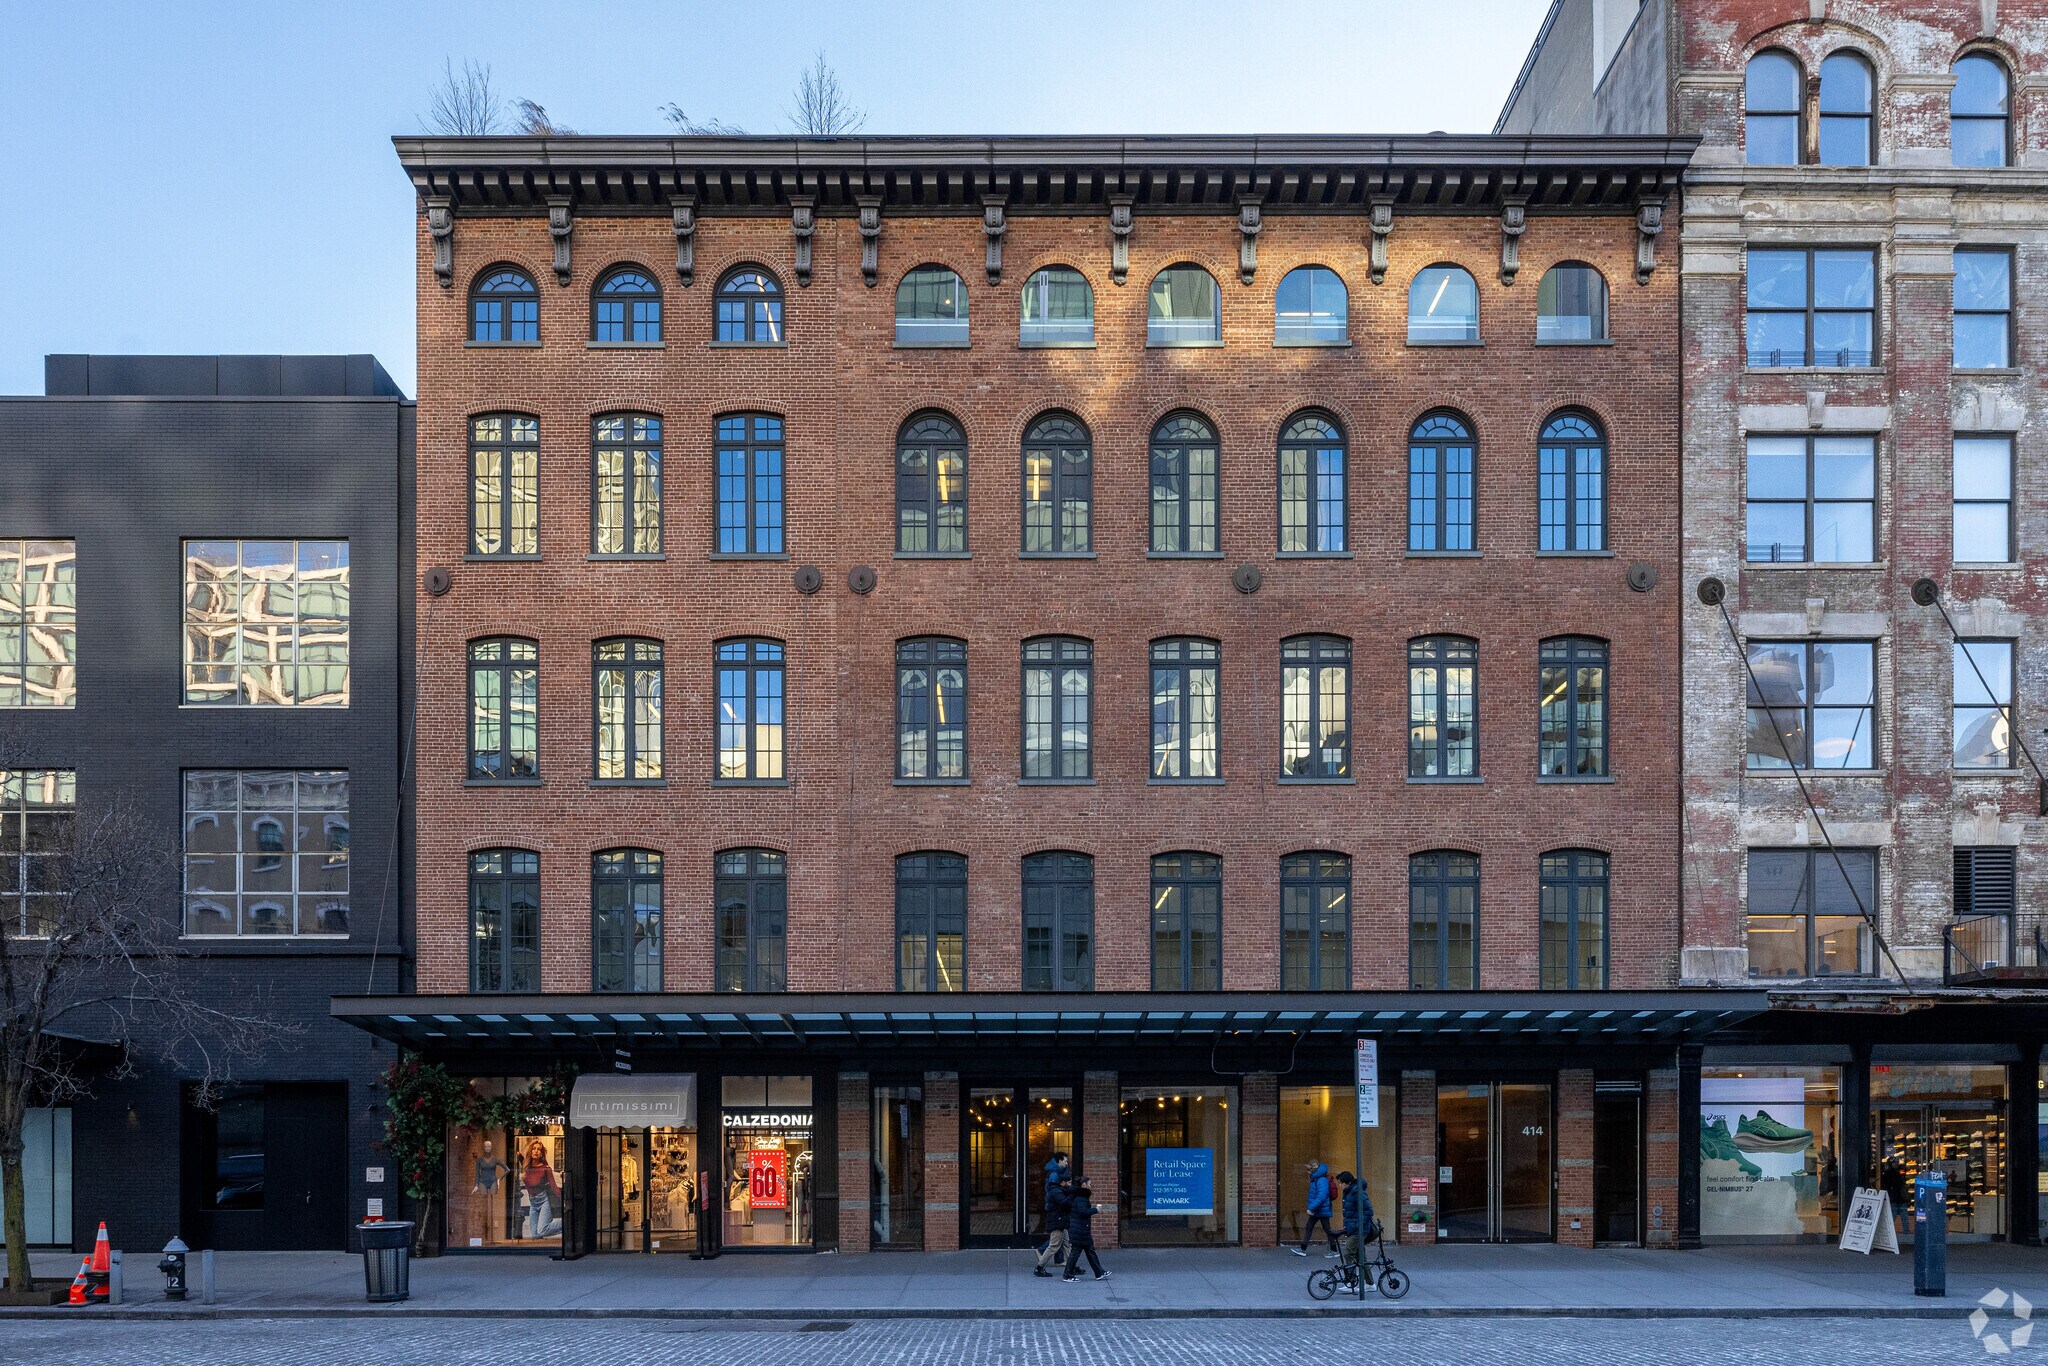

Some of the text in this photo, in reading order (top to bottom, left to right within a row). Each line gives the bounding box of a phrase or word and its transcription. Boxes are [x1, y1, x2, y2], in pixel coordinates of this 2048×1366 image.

[1360, 1041, 1364, 1049] 3
[1361, 1086, 1365, 1094] 2
[584, 1101, 673, 1111] intimissimi
[1522, 1126, 1544, 1136] 414
[1153, 1160, 1206, 1170] Retail Space
[1153, 1169, 1194, 1178] for Lease
[753, 1167, 777, 1198] 60
[1706, 1175, 1719, 1183] feel
[1719, 1175, 1744, 1183] comfort
[1919, 1187, 1926, 1198] P
[167, 1276, 179, 1288] 12
